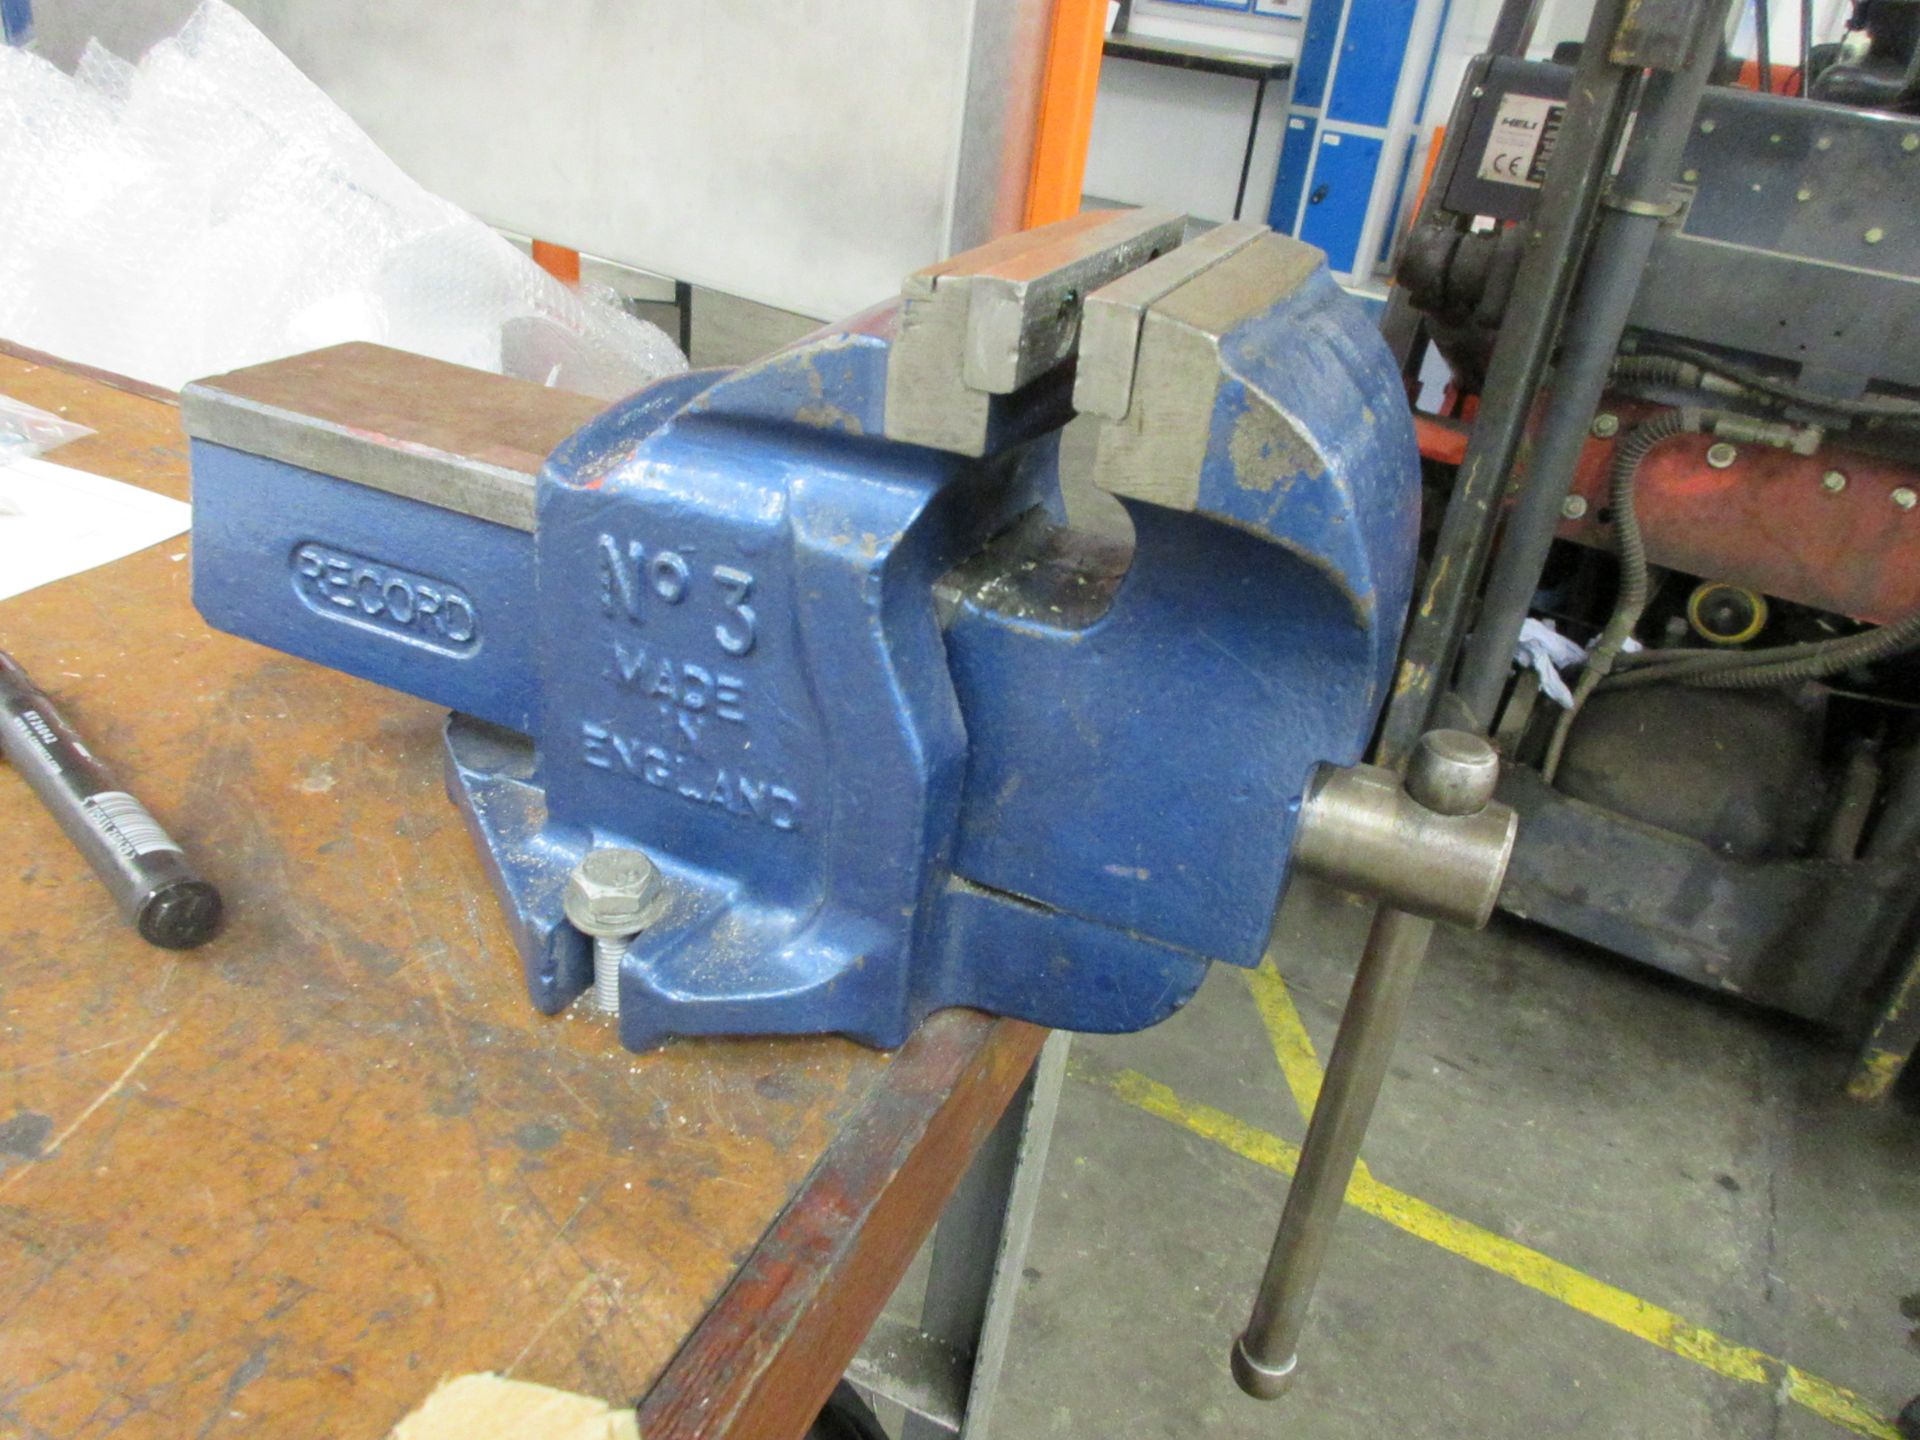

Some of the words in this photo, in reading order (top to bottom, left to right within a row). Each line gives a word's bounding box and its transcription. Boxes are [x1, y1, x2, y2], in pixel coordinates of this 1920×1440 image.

[299, 549, 475, 642] RECORD
[711, 564, 756, 656] 3
[605, 640, 745, 722] MADE
[582, 721, 798, 830] ENGLAND
